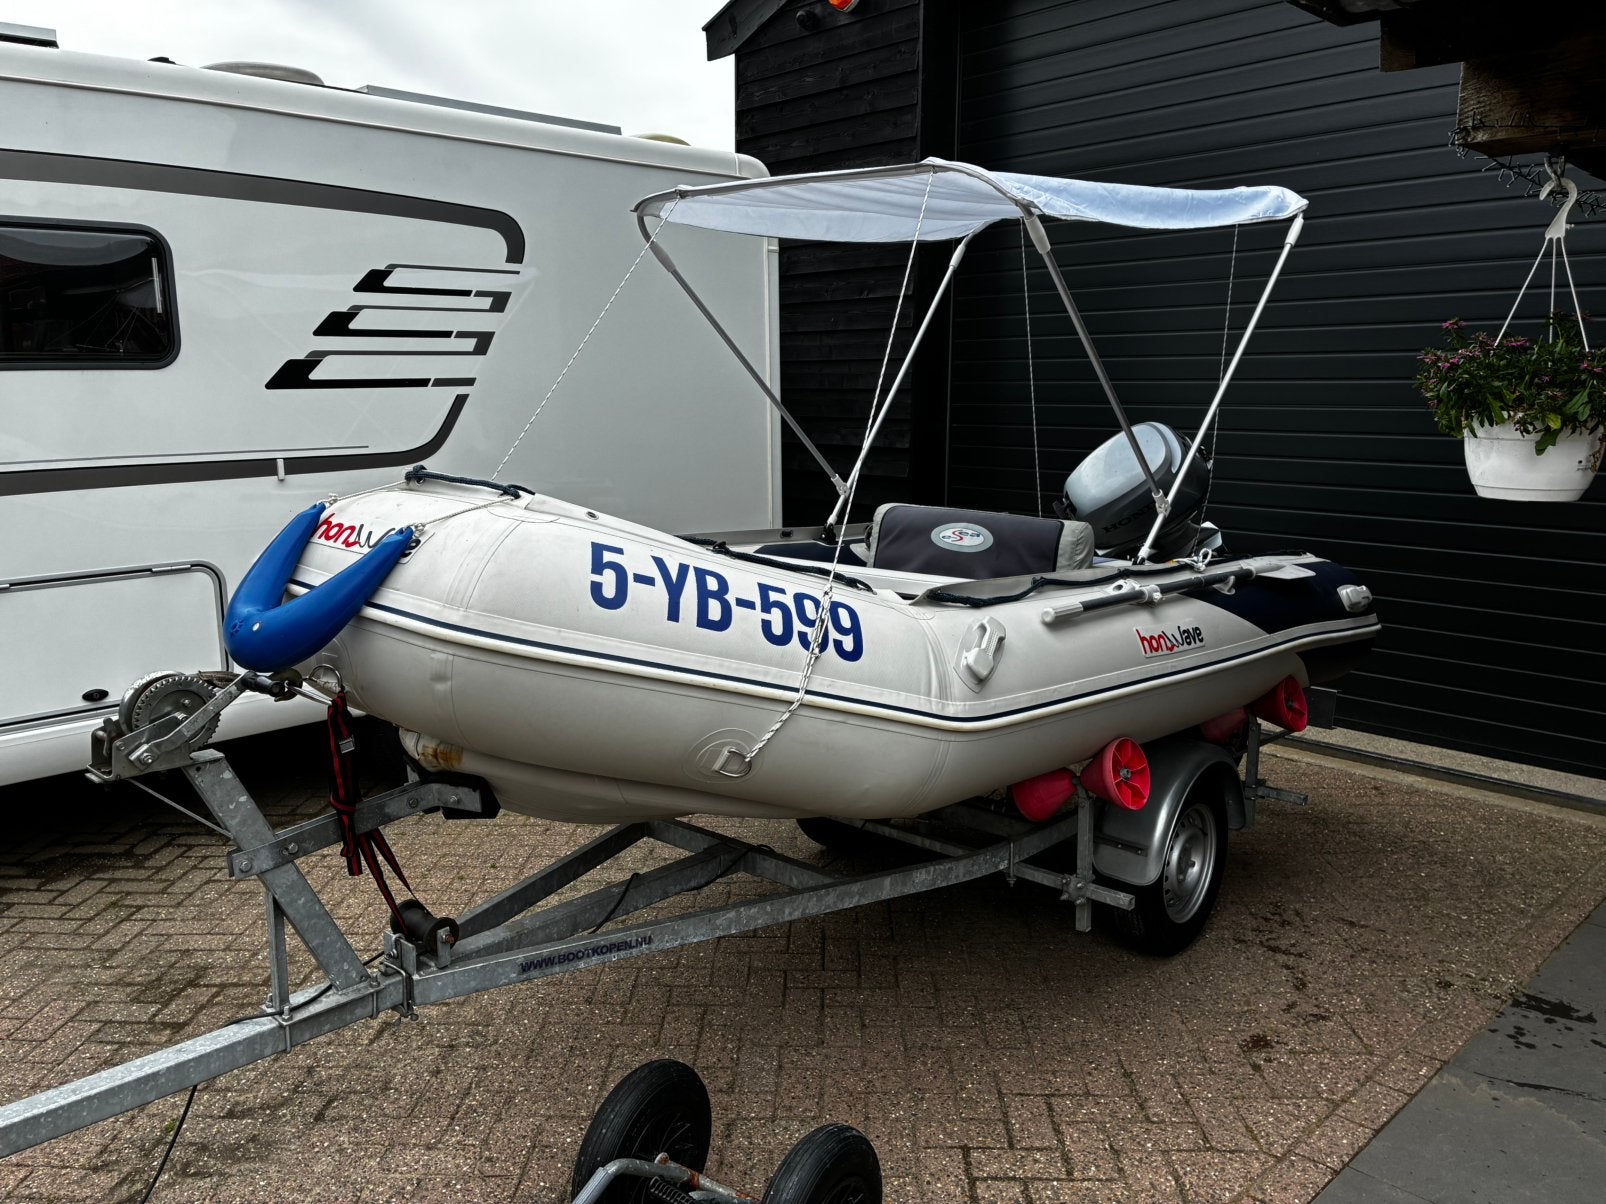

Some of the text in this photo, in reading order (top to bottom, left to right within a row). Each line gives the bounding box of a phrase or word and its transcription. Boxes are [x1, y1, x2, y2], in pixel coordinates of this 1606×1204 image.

[1102, 501, 1156, 534] HOND
[590, 541, 863, 662] 5-YB-599
[520, 936, 654, 973] WWW.BOOTKOPEN.NU
